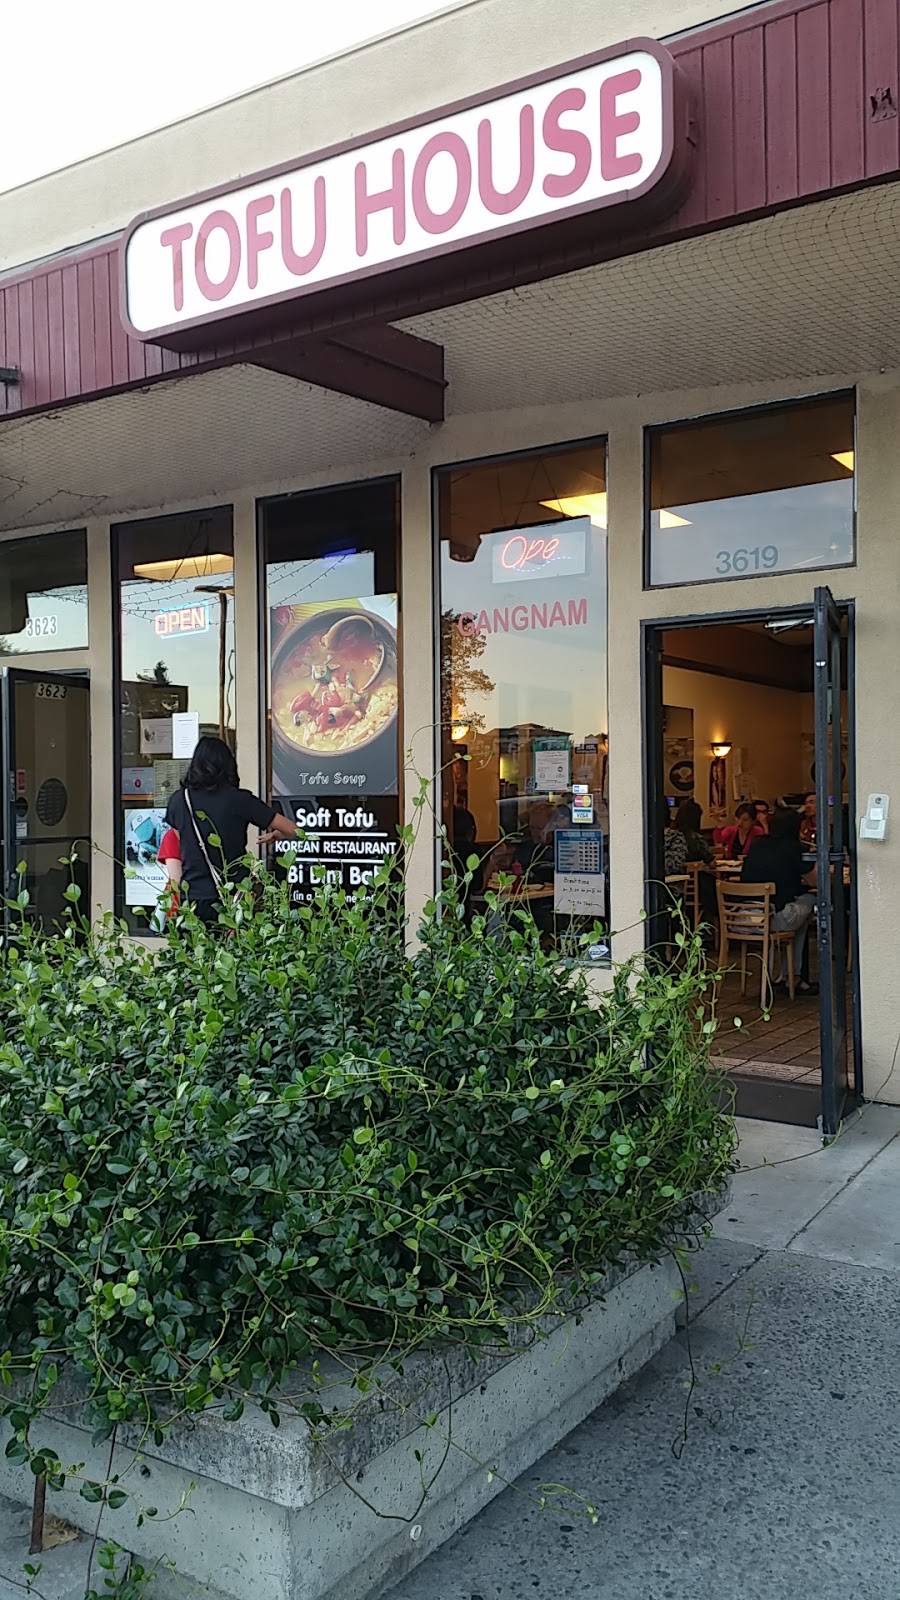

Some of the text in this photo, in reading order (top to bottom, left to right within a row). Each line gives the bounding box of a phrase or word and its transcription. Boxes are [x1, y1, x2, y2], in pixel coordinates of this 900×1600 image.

[160, 68, 643, 312] TOFU HOUSE
[716, 544, 779, 574] 3619
[26, 616, 57, 637] 3623
[155, 607, 206, 635] OPEN
[458, 598, 588, 637] GANGNAM
[38, 683, 68, 699] 3623
[299, 772, 366, 787] Tofu Soup
[296, 807, 374, 828] Soft Tofu
[275, 840, 397, 855] KOREAN RESTAURANT
[288, 864, 304, 884] Bi
